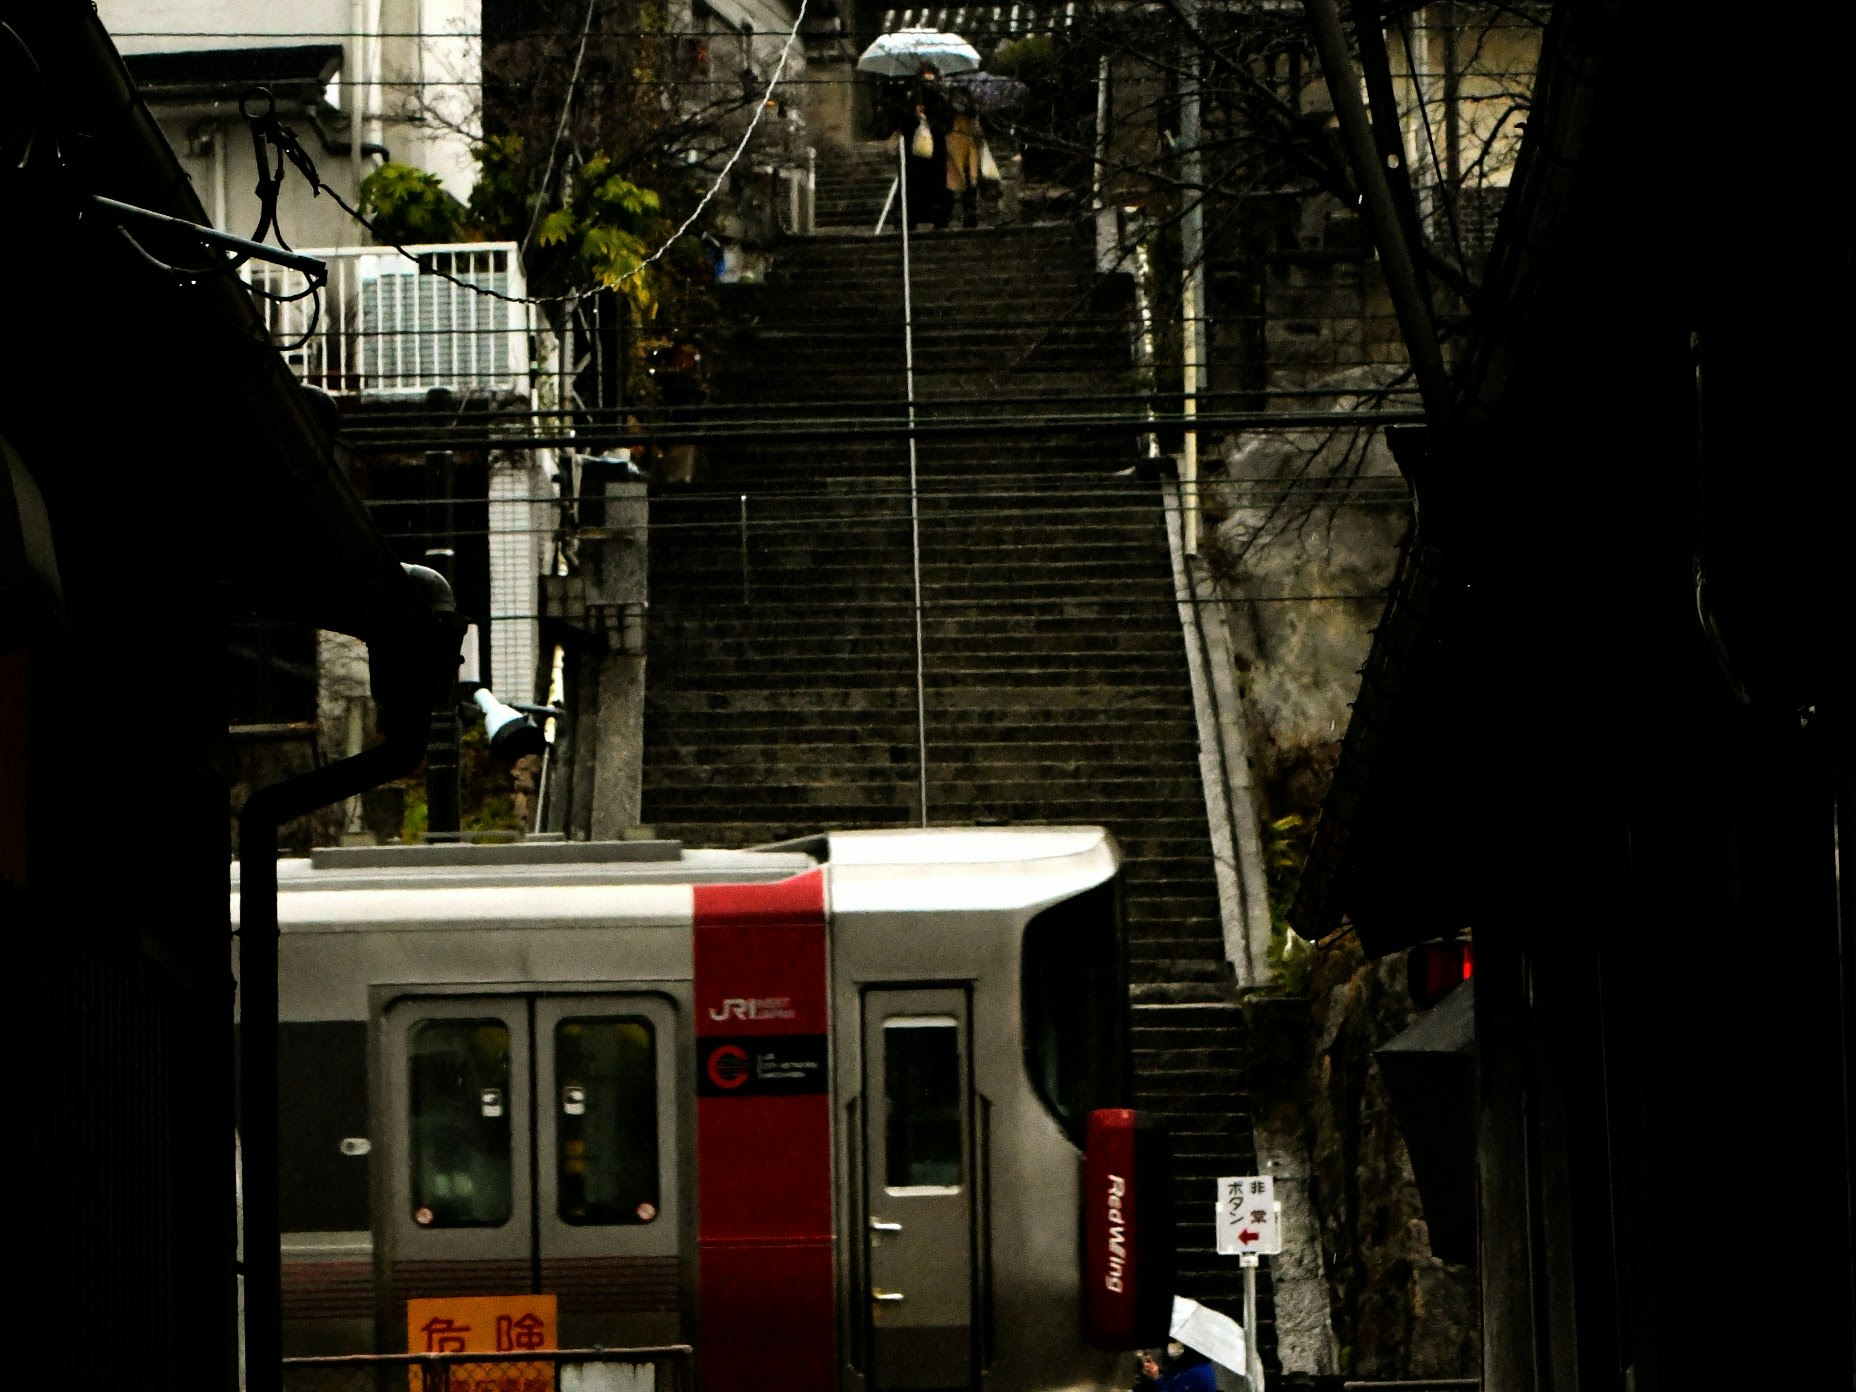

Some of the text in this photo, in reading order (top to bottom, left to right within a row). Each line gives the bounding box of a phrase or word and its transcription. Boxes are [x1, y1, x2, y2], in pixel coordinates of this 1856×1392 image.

[1249, 1180, 1267, 1225] 非常
[1105, 1174, 1127, 1293] RedWing
[421, 1312, 546, 1354] 危険
